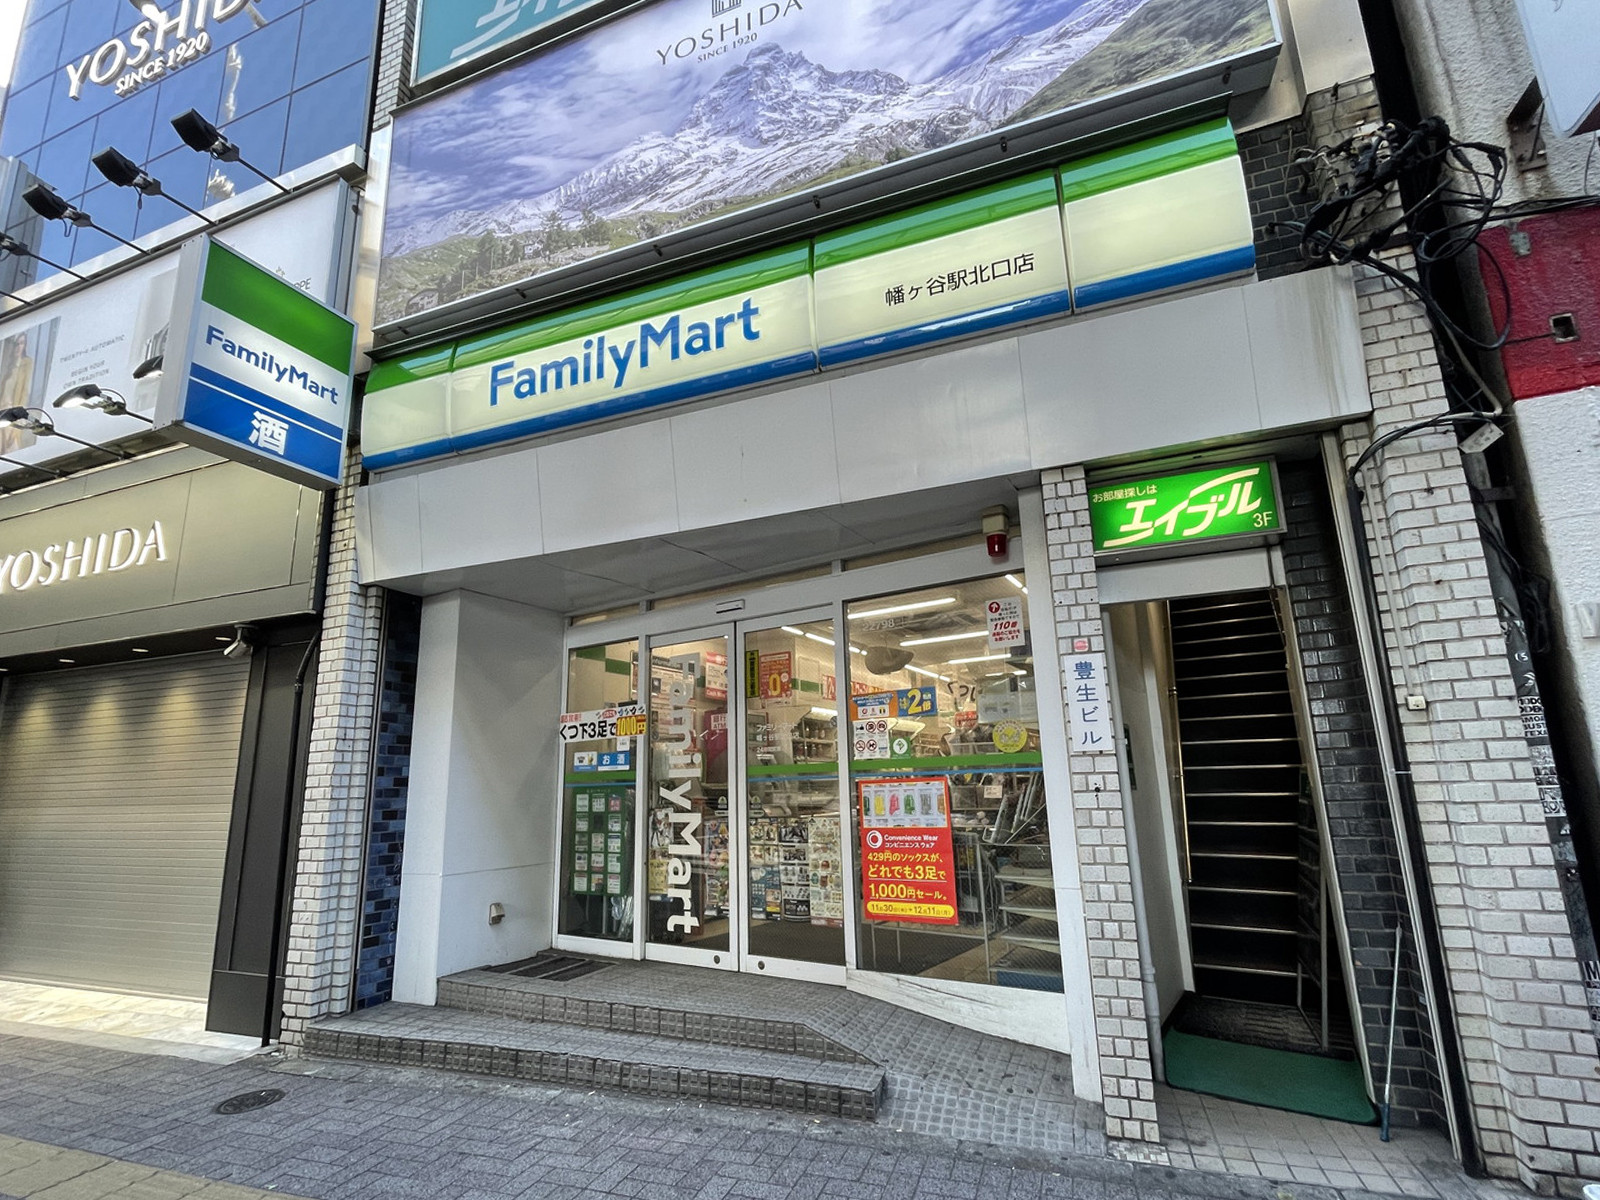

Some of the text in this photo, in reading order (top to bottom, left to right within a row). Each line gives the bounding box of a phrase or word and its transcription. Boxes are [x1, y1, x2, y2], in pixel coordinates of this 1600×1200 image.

[656, 0, 803, 65] YOSHIDA
[698, 32, 758, 64] SINCE 1920
[114, 32, 211, 97] SINCE 1920
[205, 324, 339, 406] FamilyMart
[489, 296, 760, 406] FamilyMart
[248, 410, 289, 456] 酒
[1092, 485, 1158, 504] お部屋探しは
[1112, 474, 1262, 541] エイブル
[1252, 511, 1273, 528] 3F
[1073, 661, 1103, 745] 豊生ビル
[559, 719, 617, 741] くつ下3足で
[602, 753, 626, 765] お酒
[659, 652, 702, 934] FamilyMart
[884, 833, 938, 842] Convenience Wear
[868, 864, 946, 880] どれでも3足で
[869, 883, 947, 900] 1,000円セール。
